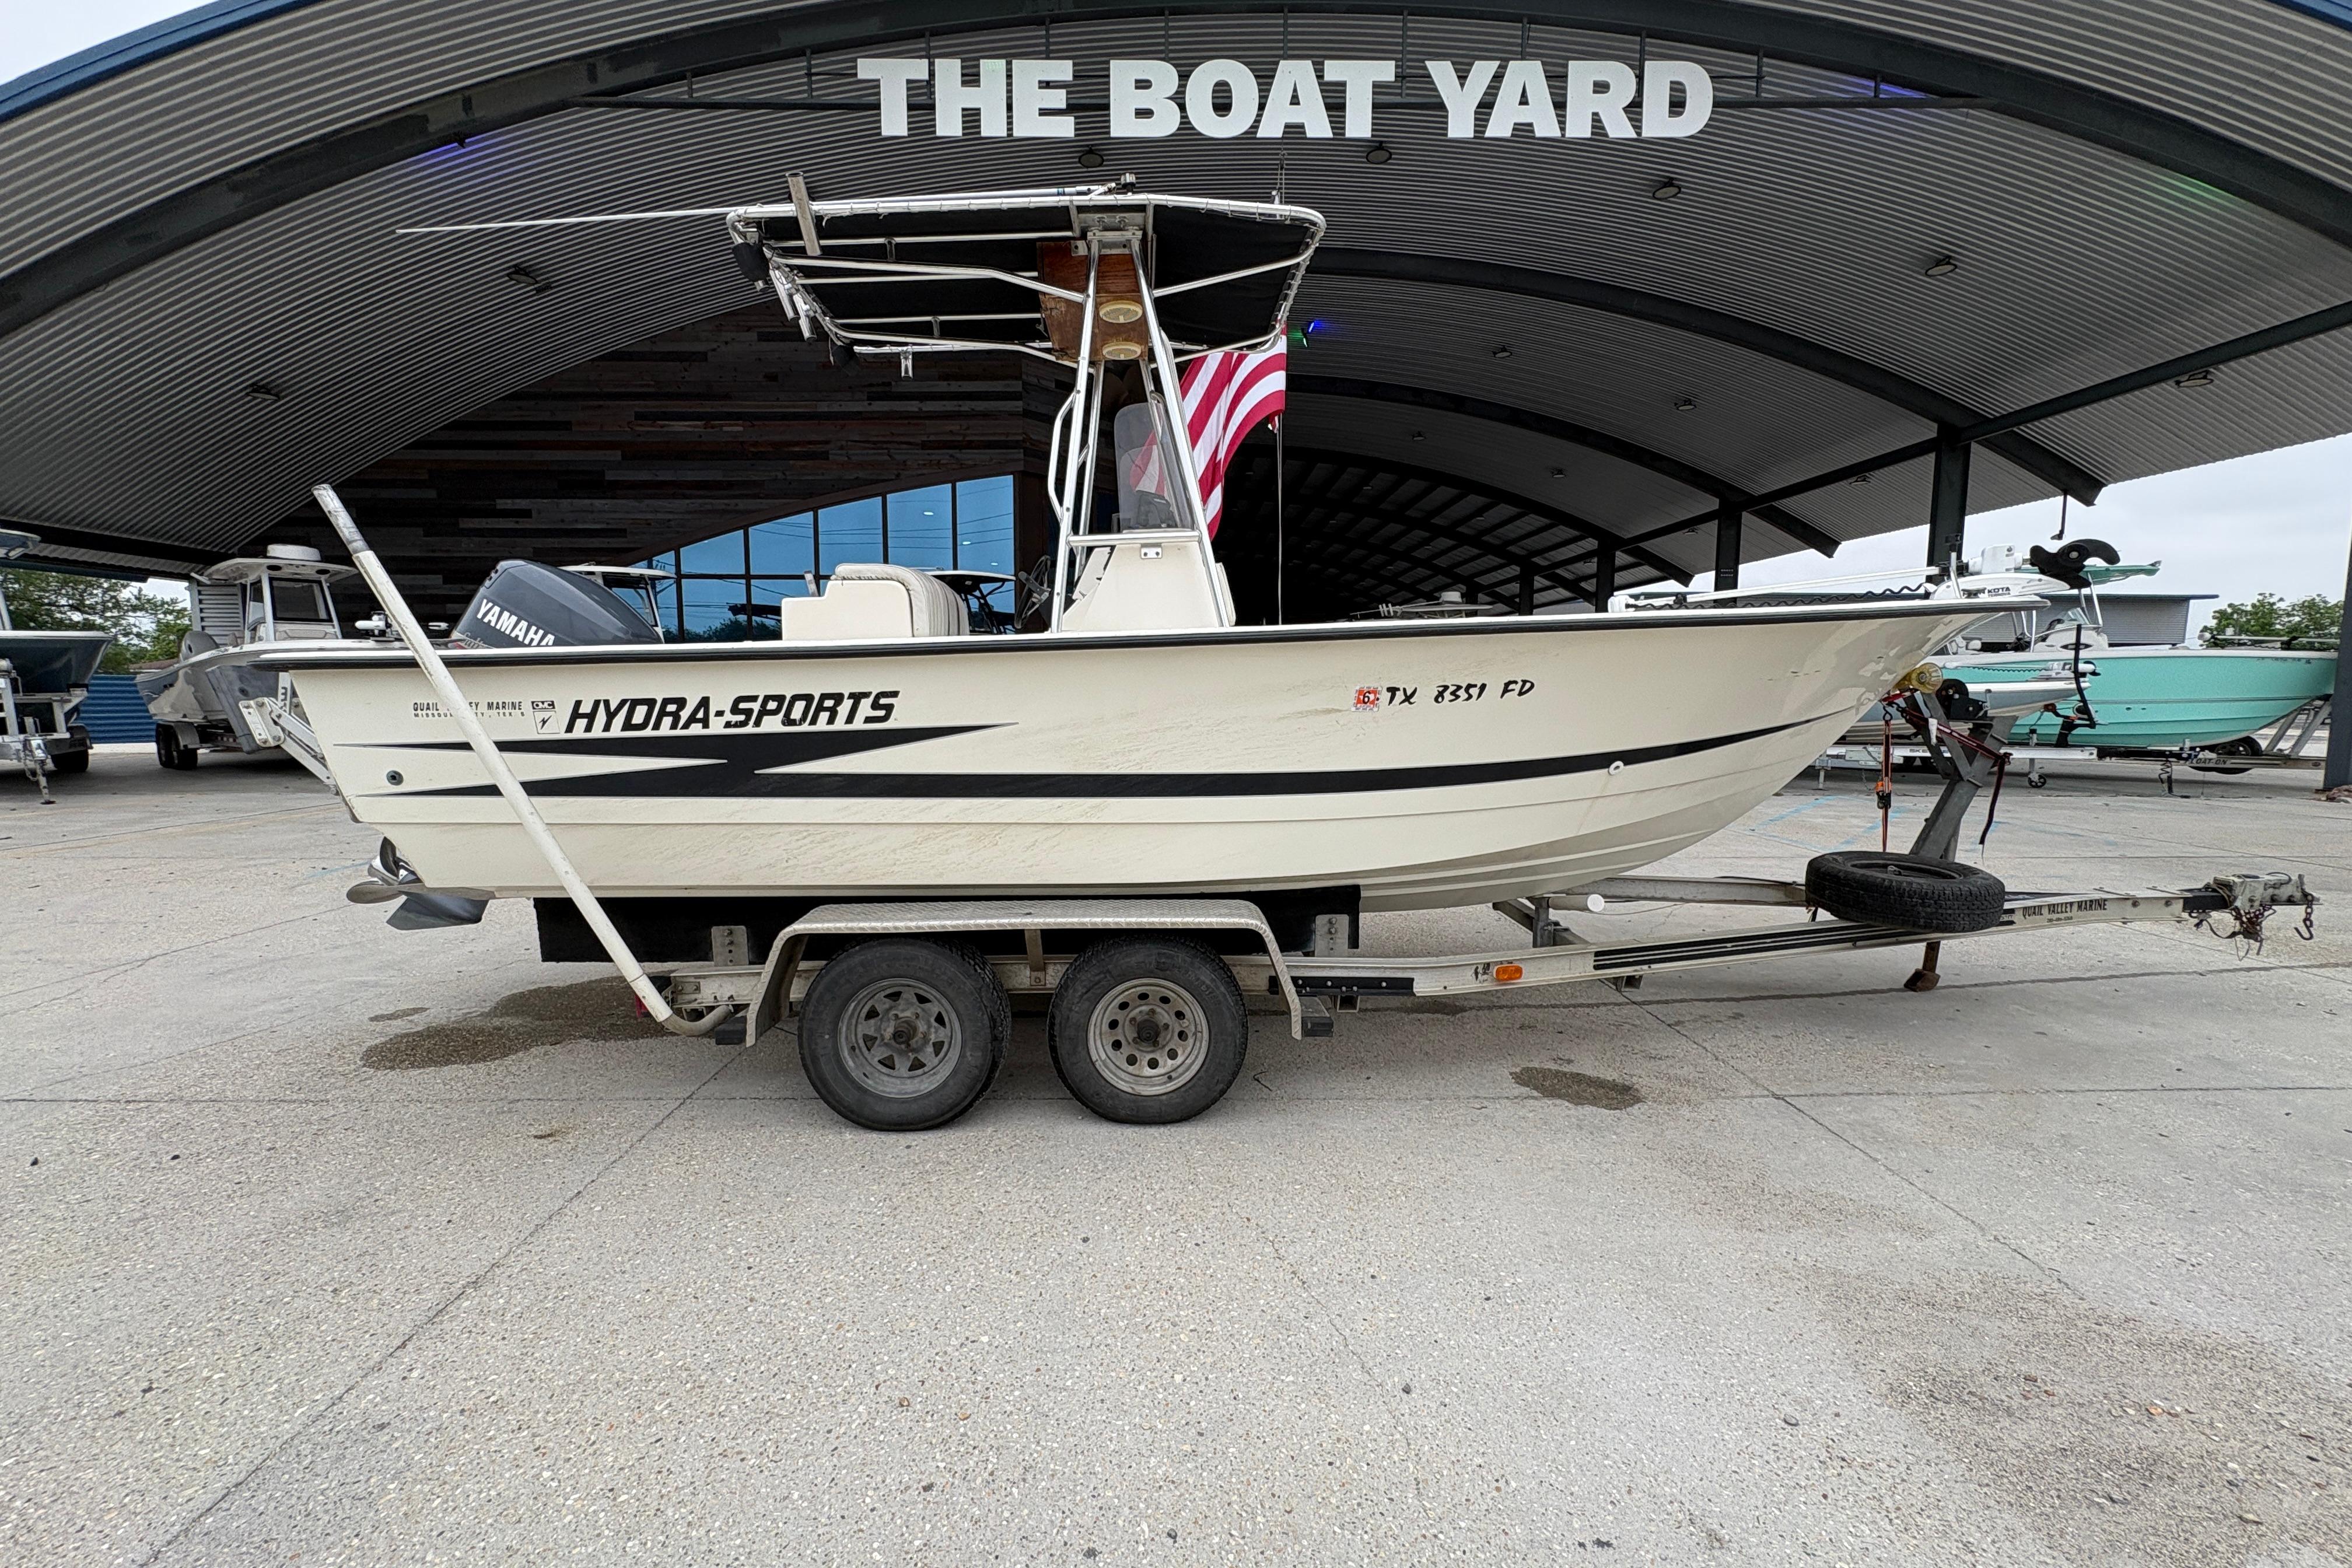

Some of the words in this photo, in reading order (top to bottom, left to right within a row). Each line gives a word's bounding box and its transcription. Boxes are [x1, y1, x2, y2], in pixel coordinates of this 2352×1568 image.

[857, 59, 1074, 137] THE
[1110, 59, 1396, 138] BOAT
[1425, 60, 1713, 138] YARD
[476, 598, 555, 646] YAMAHA
[413, 702, 439, 711] QUAIL
[487, 701, 523, 710] MARINE
[1387, 687, 1418, 706] TX
[1434, 683, 1488, 704] 8351
[1500, 679, 1535, 699] FD
[564, 690, 900, 733] HYDRA-SPORTS
[2022, 907, 2044, 919] QUAIL
[2048, 901, 2072, 915] VALLEY
[2077, 899, 2107, 912] MARINE
